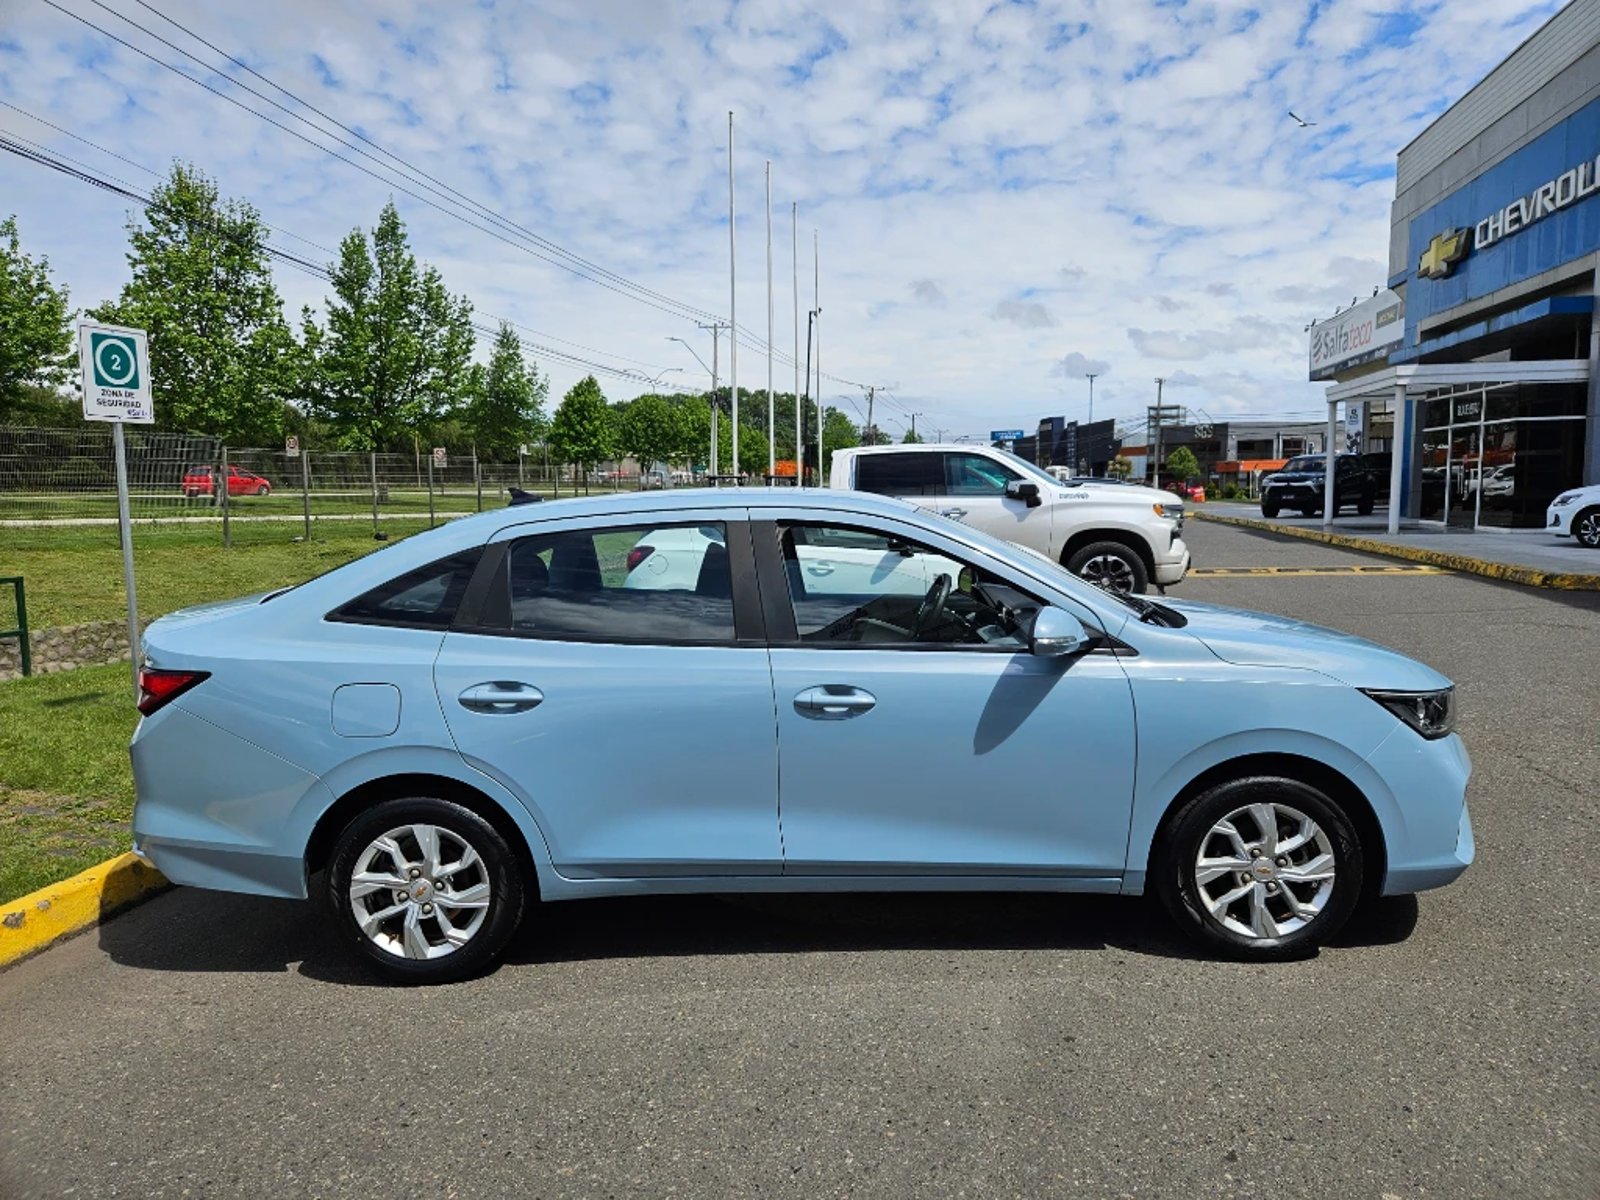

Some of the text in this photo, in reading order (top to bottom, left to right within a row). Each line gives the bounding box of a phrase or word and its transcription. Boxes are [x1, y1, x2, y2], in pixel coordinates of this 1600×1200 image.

[1474, 155, 1600, 250] CHEVROL
[110, 354, 121, 371] 2
[101, 388, 135, 399] ZONA DE
[96, 398, 142, 408] SEGURIDAD
[1194, 424, 1214, 439] SGS
